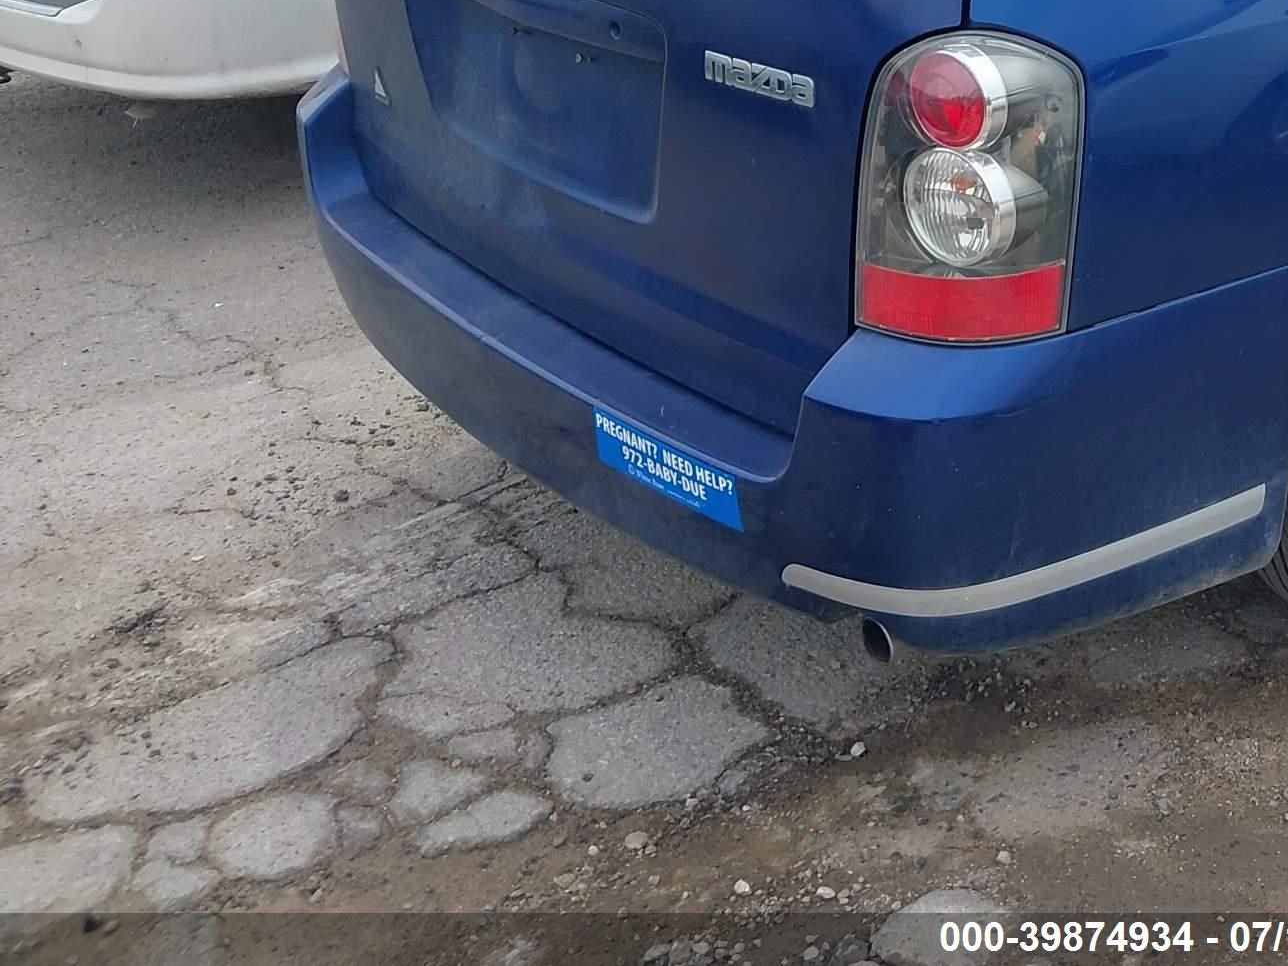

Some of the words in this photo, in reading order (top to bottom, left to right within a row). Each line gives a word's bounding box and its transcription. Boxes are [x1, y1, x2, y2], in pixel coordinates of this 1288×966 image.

[595, 412, 658, 459] PREGNANT?
[662, 448, 693, 477] NEED
[695, 465, 733, 496] HELP?
[621, 445, 707, 501] 972-BABY-DUE
